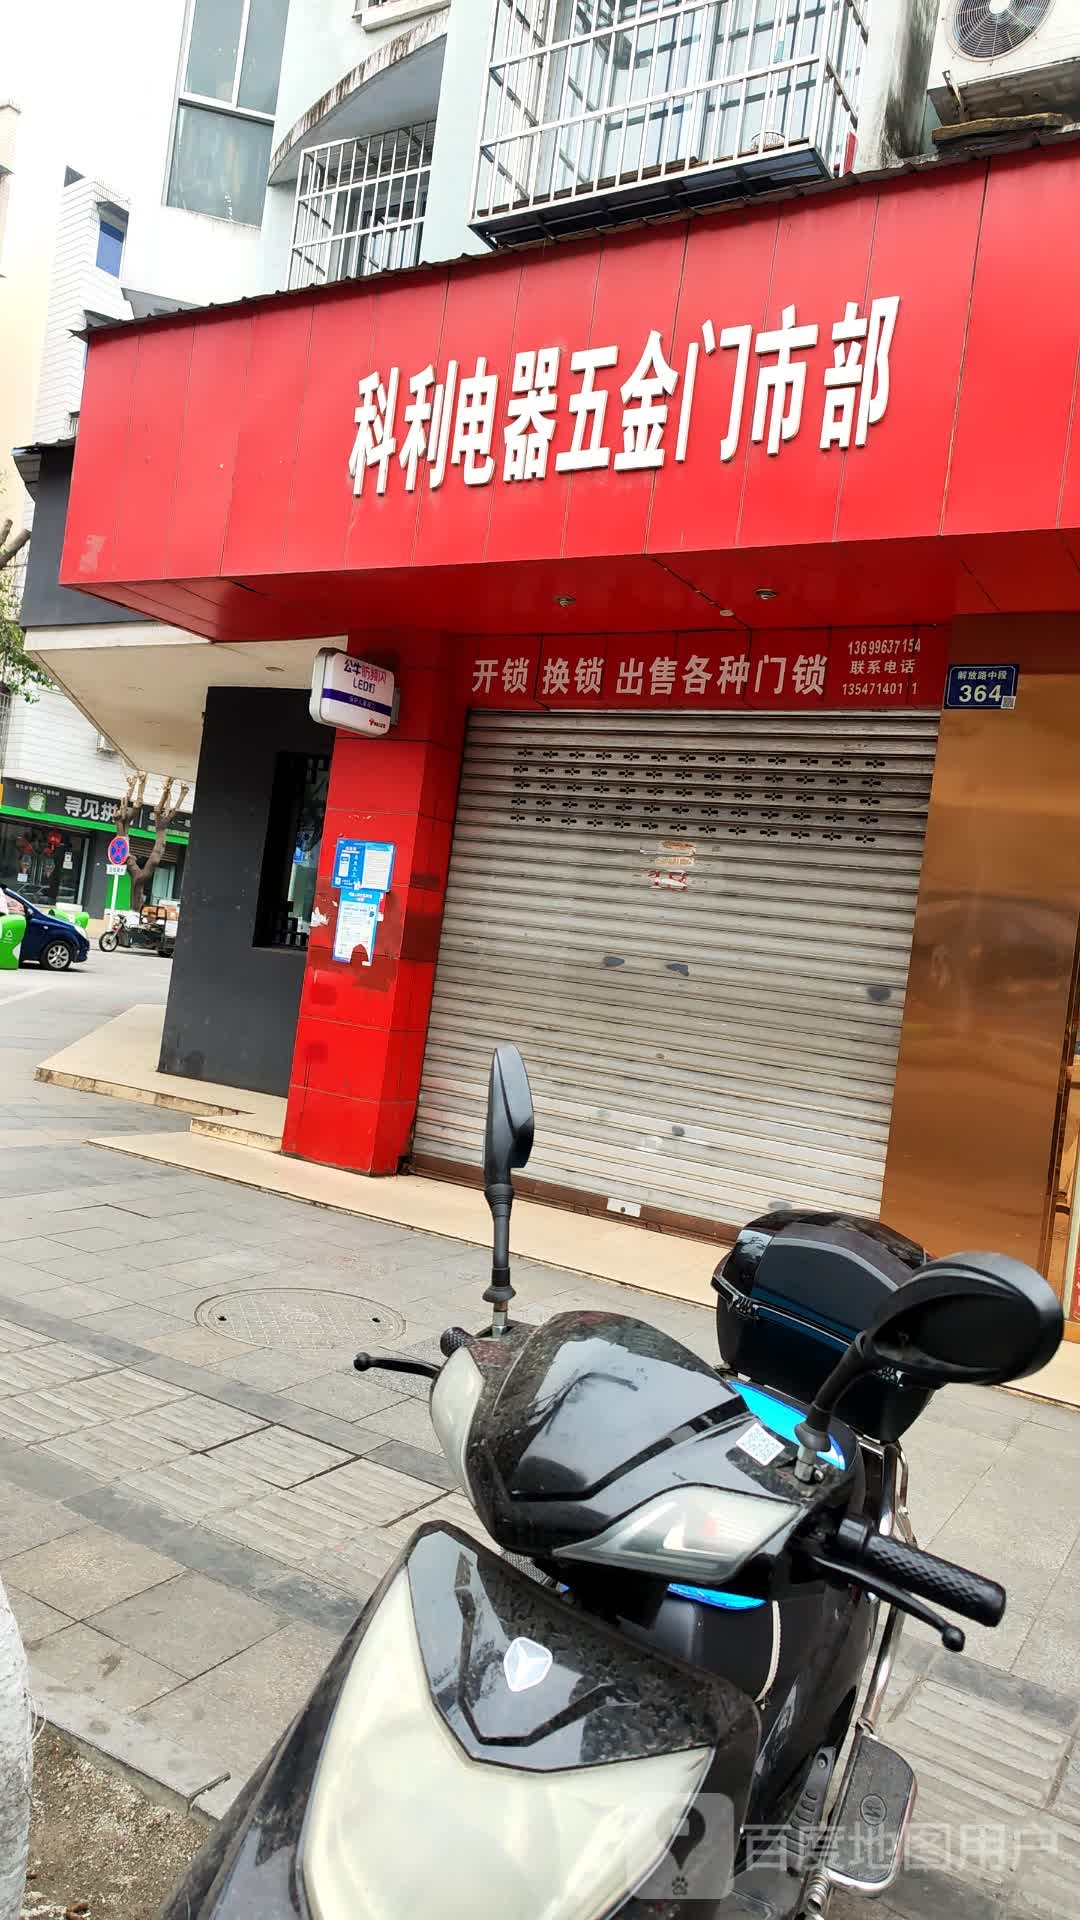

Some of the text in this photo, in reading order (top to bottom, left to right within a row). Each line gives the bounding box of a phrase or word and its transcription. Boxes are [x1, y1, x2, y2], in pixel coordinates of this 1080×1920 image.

[348, 296, 901, 497] 科利电器五金门市部
[848, 638, 921, 656] 13699637154
[472, 654, 828, 696] 开锁 换锁 出售各种门锁
[849, 659, 916, 675] 联系电话
[957, 670, 1008, 681] 解放路中段
[352, 677, 376, 695] LED灯
[958, 684, 1002, 703] 364
